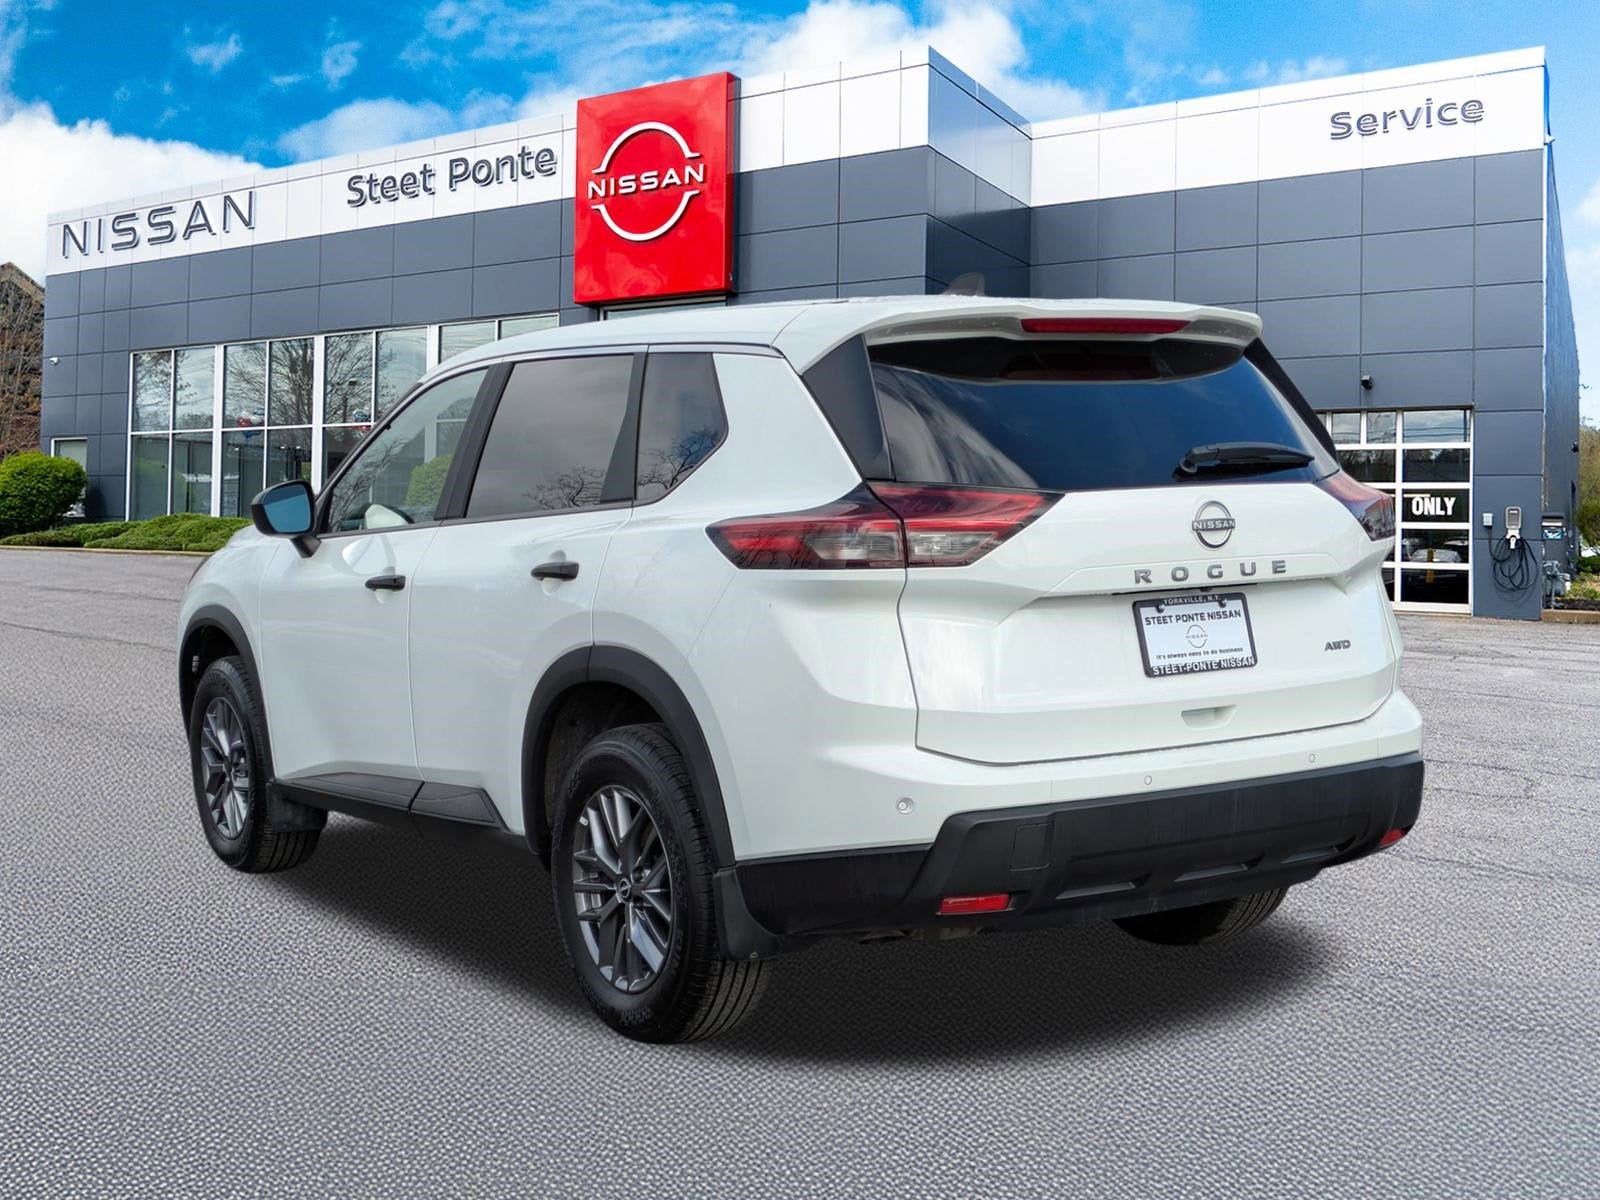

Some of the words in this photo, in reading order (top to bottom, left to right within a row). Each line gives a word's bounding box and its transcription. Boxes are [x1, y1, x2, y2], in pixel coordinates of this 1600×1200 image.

[1330, 98, 1484, 140] Service
[347, 163, 436, 207] Steet
[449, 145, 557, 191] Ponte
[587, 163, 705, 199] NISSAN
[62, 190, 255, 259] NISSAN
[1411, 496, 1456, 516] ONLY
[1192, 517, 1236, 531] NISSAN
[1134, 559, 1287, 585] ROGUE
[1144, 615, 1173, 626] STEET
[1175, 612, 1206, 623] PONTE
[1207, 609, 1242, 620] NISSAN
[1324, 640, 1351, 651] AWD
[1220, 656, 1255, 669] NISSAN
